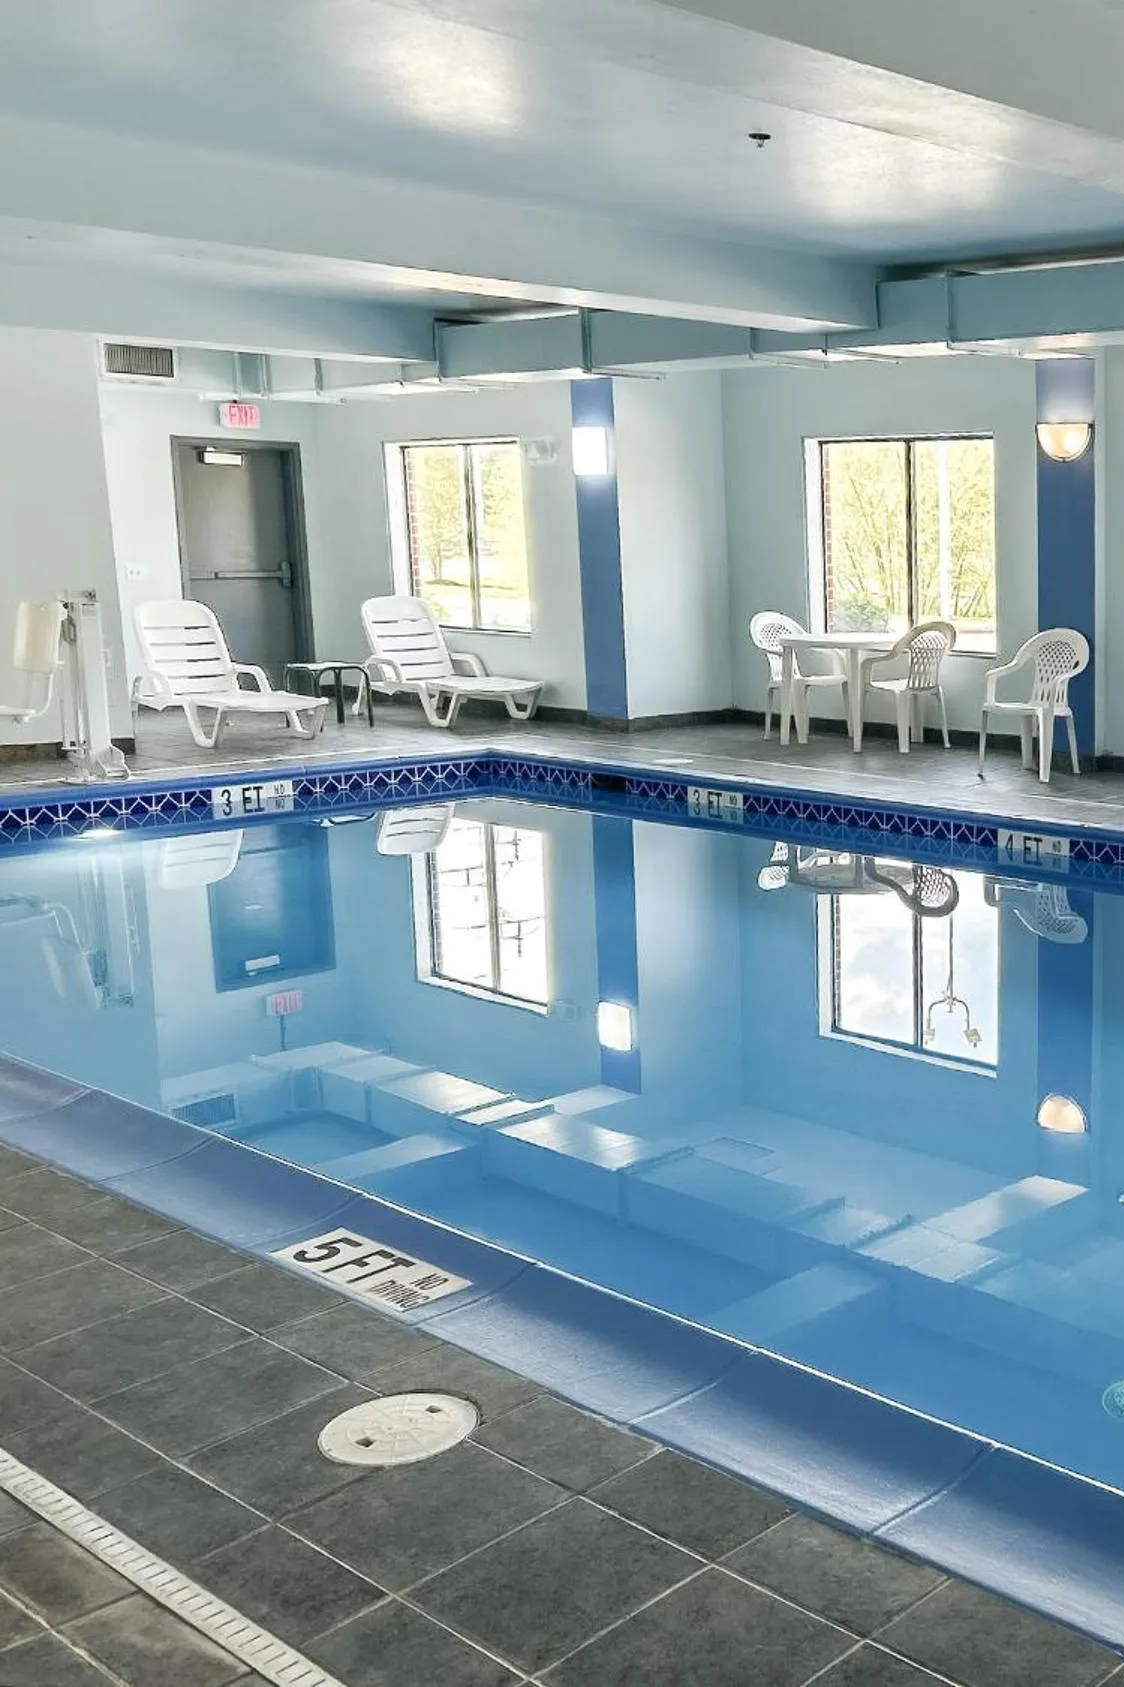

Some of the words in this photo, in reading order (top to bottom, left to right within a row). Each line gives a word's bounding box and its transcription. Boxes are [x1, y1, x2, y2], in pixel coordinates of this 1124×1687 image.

[228, 405, 256, 426] EXIT
[221, 789, 233, 812] 3
[293, 1237, 363, 1263] 5
[321, 1249, 416, 1284] FT
[410, 1273, 449, 1291] NO
